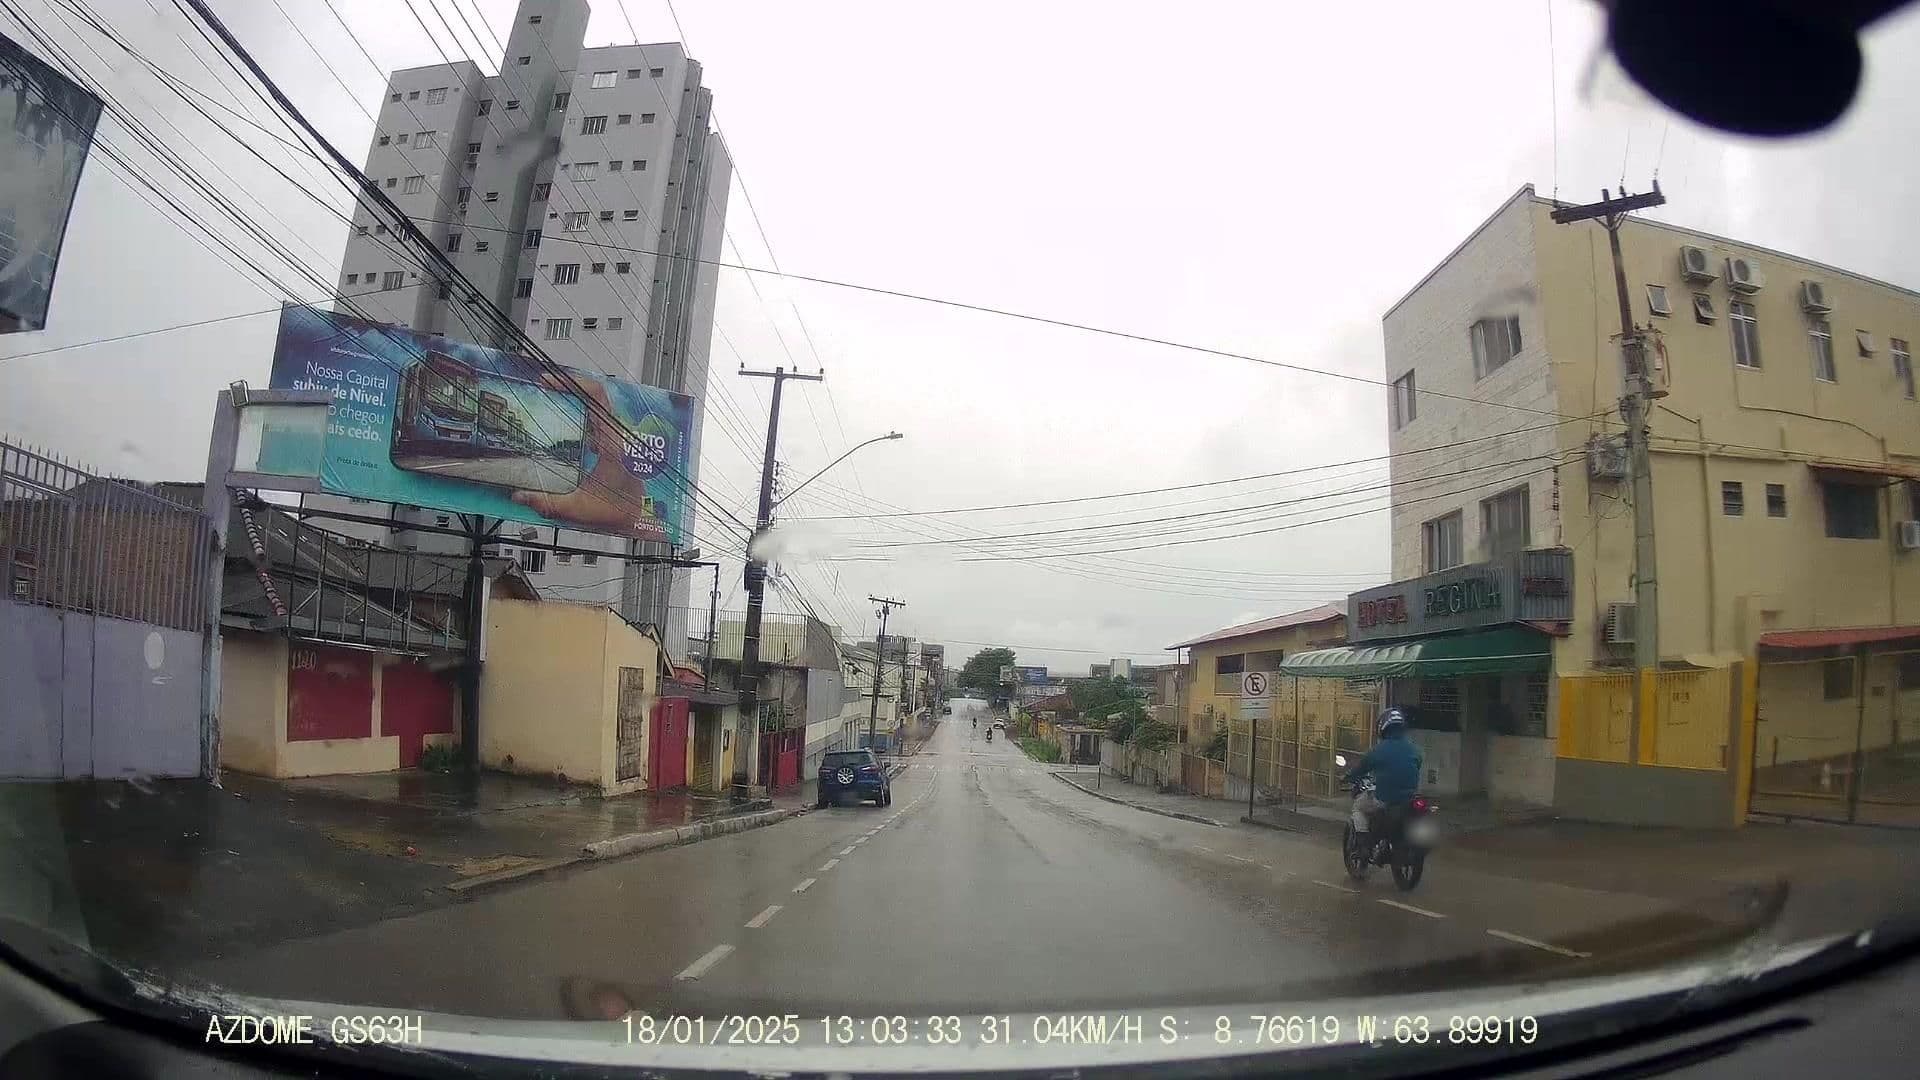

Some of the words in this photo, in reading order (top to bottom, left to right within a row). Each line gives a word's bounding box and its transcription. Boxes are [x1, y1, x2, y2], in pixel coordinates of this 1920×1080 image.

[306, 361, 343, 381] Nossa
[346, 369, 389, 390] Capital
[293, 377, 328, 390] subi
[331, 384, 347, 400] de
[340, 404, 385, 426] chegou
[327, 421, 345, 436] ais
[348, 425, 382, 442] cedo.
[633, 461, 653, 474] 2024
